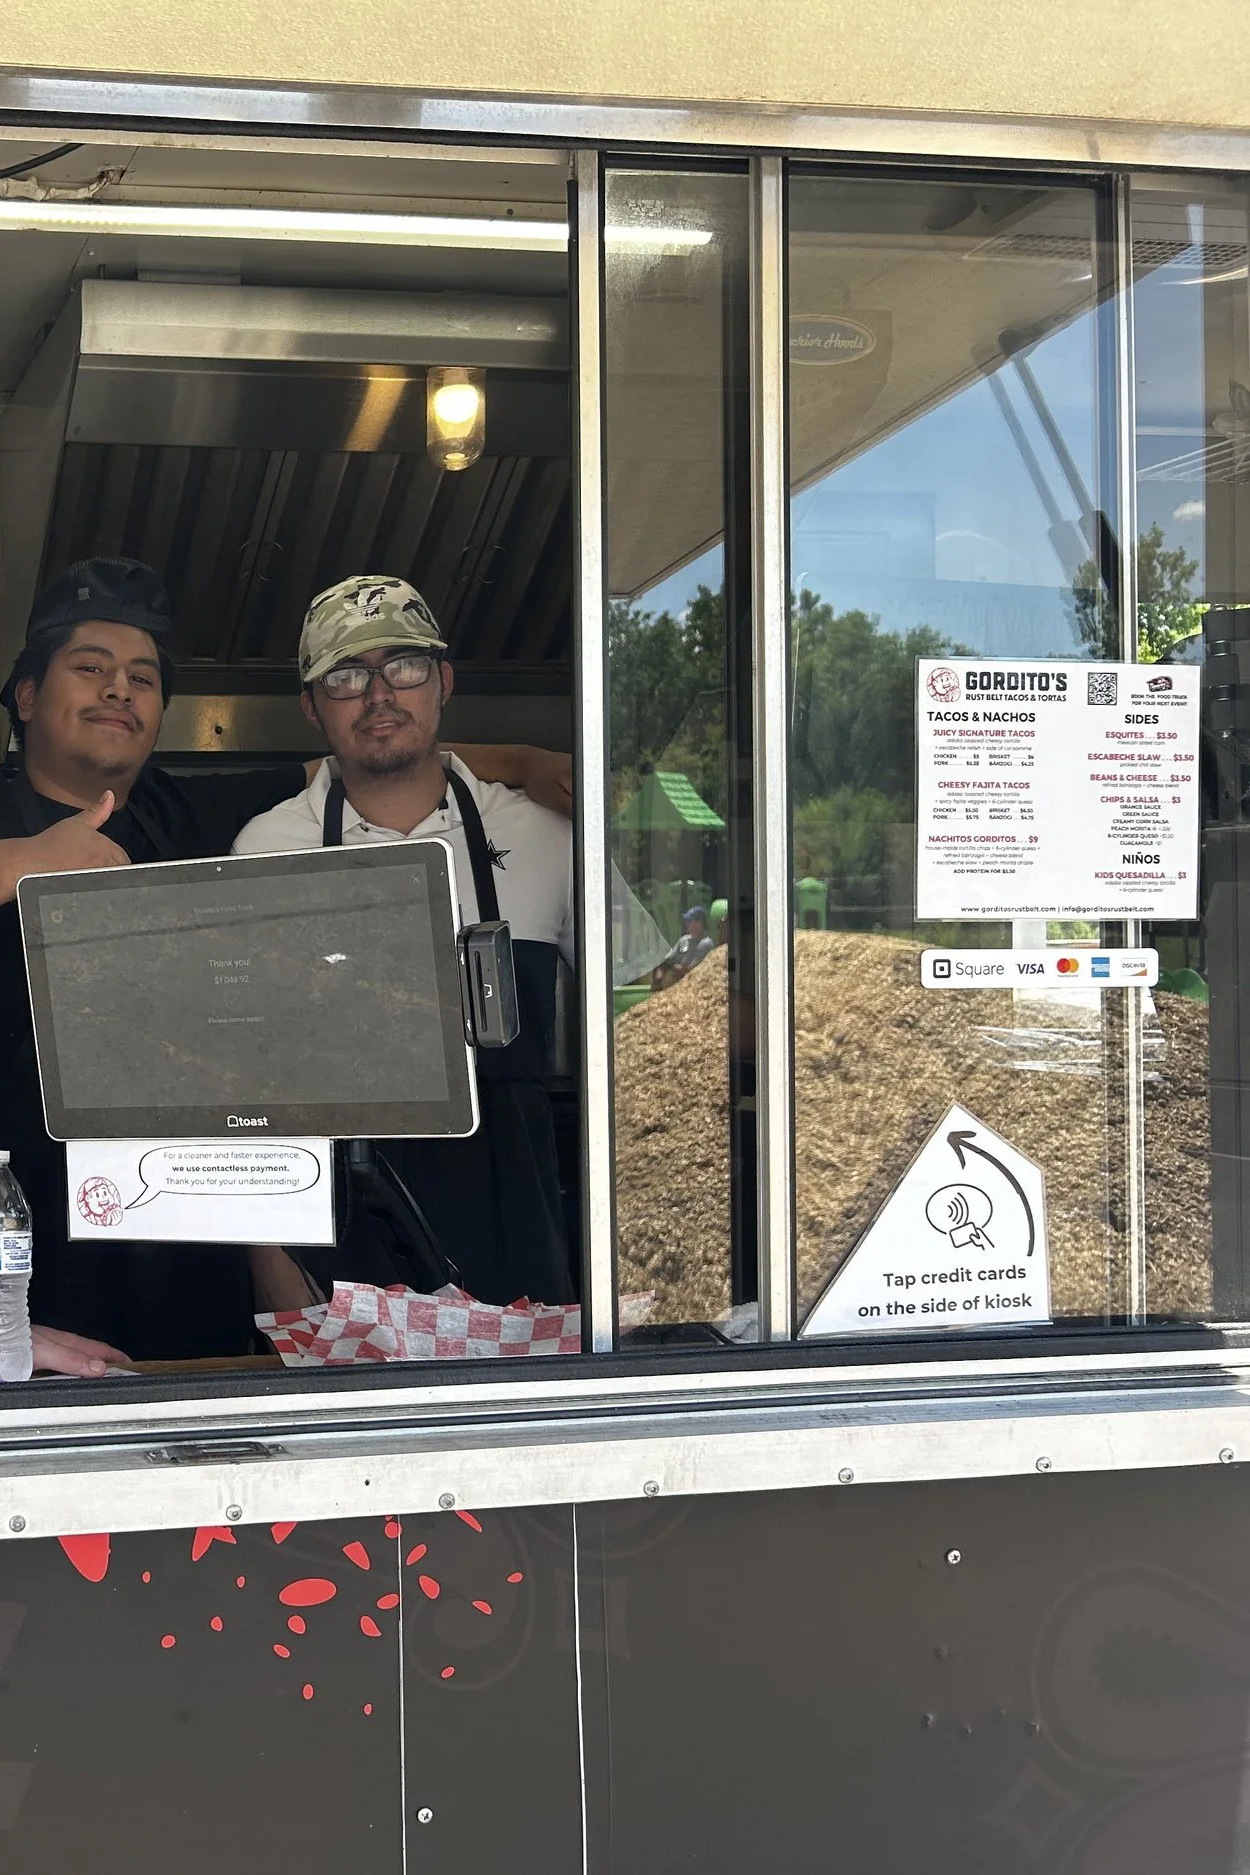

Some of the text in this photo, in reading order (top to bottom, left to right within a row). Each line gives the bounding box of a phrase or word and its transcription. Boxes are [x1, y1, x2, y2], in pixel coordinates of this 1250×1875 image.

[966, 672, 1067, 691] GORDITO'S
[928, 712, 1036, 722] TACOS & NACHOS
[1125, 714, 1159, 724] SIDES
[1122, 852, 1160, 864] NIÑOS
[209, 958, 251, 968] Thank you!
[956, 962, 1004, 978] Square
[1016, 963, 1045, 974] VISA
[238, 1116, 268, 1126] toast
[255, 1152, 300, 1160] experience,
[251, 1166, 290, 1174] payment.
[238, 1178, 299, 1187] understanding!
[883, 1265, 1026, 1289] Tap credit cards
[858, 1293, 1032, 1317] on the side of kiosk
